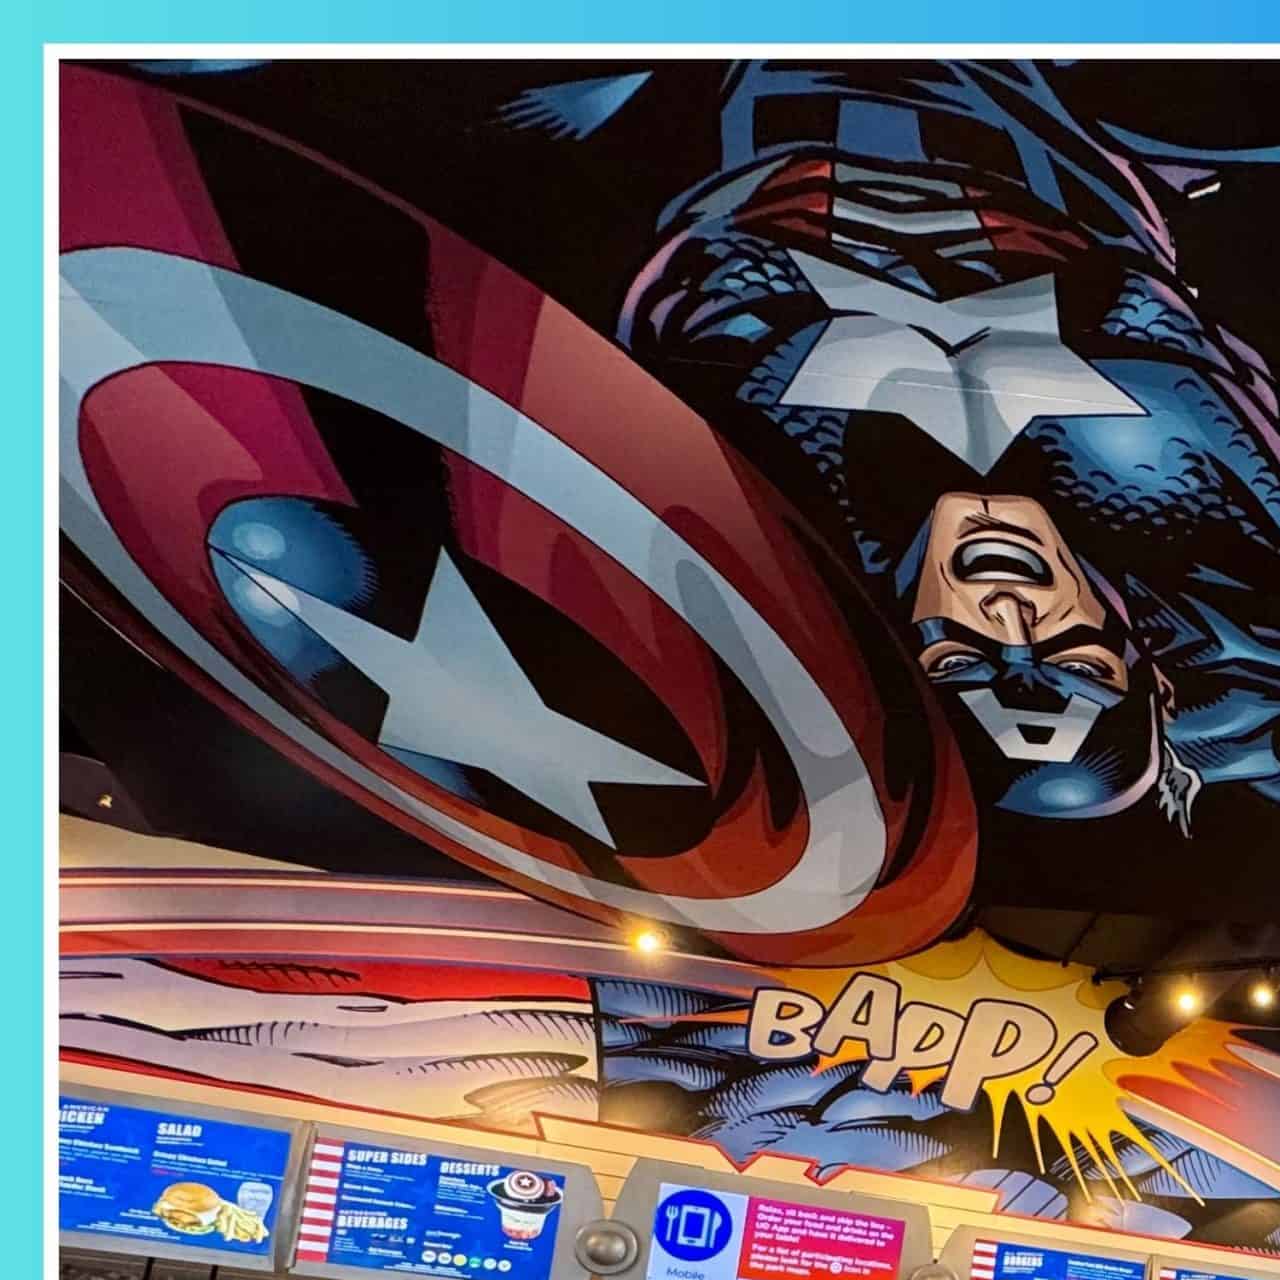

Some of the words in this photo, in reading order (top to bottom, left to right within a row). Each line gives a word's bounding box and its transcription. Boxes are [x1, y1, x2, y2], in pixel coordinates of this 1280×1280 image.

[747, 971, 1099, 1112] BAPP!
[157, 1122, 203, 1137] SALAD
[347, 1149, 389, 1164] SUPER
[390, 1152, 428, 1166] SIDES
[440, 1161, 500, 1177] DESSERTS
[336, 1215, 409, 1231] BEVERAGES
[666, 1267, 705, 1280] Mobile
